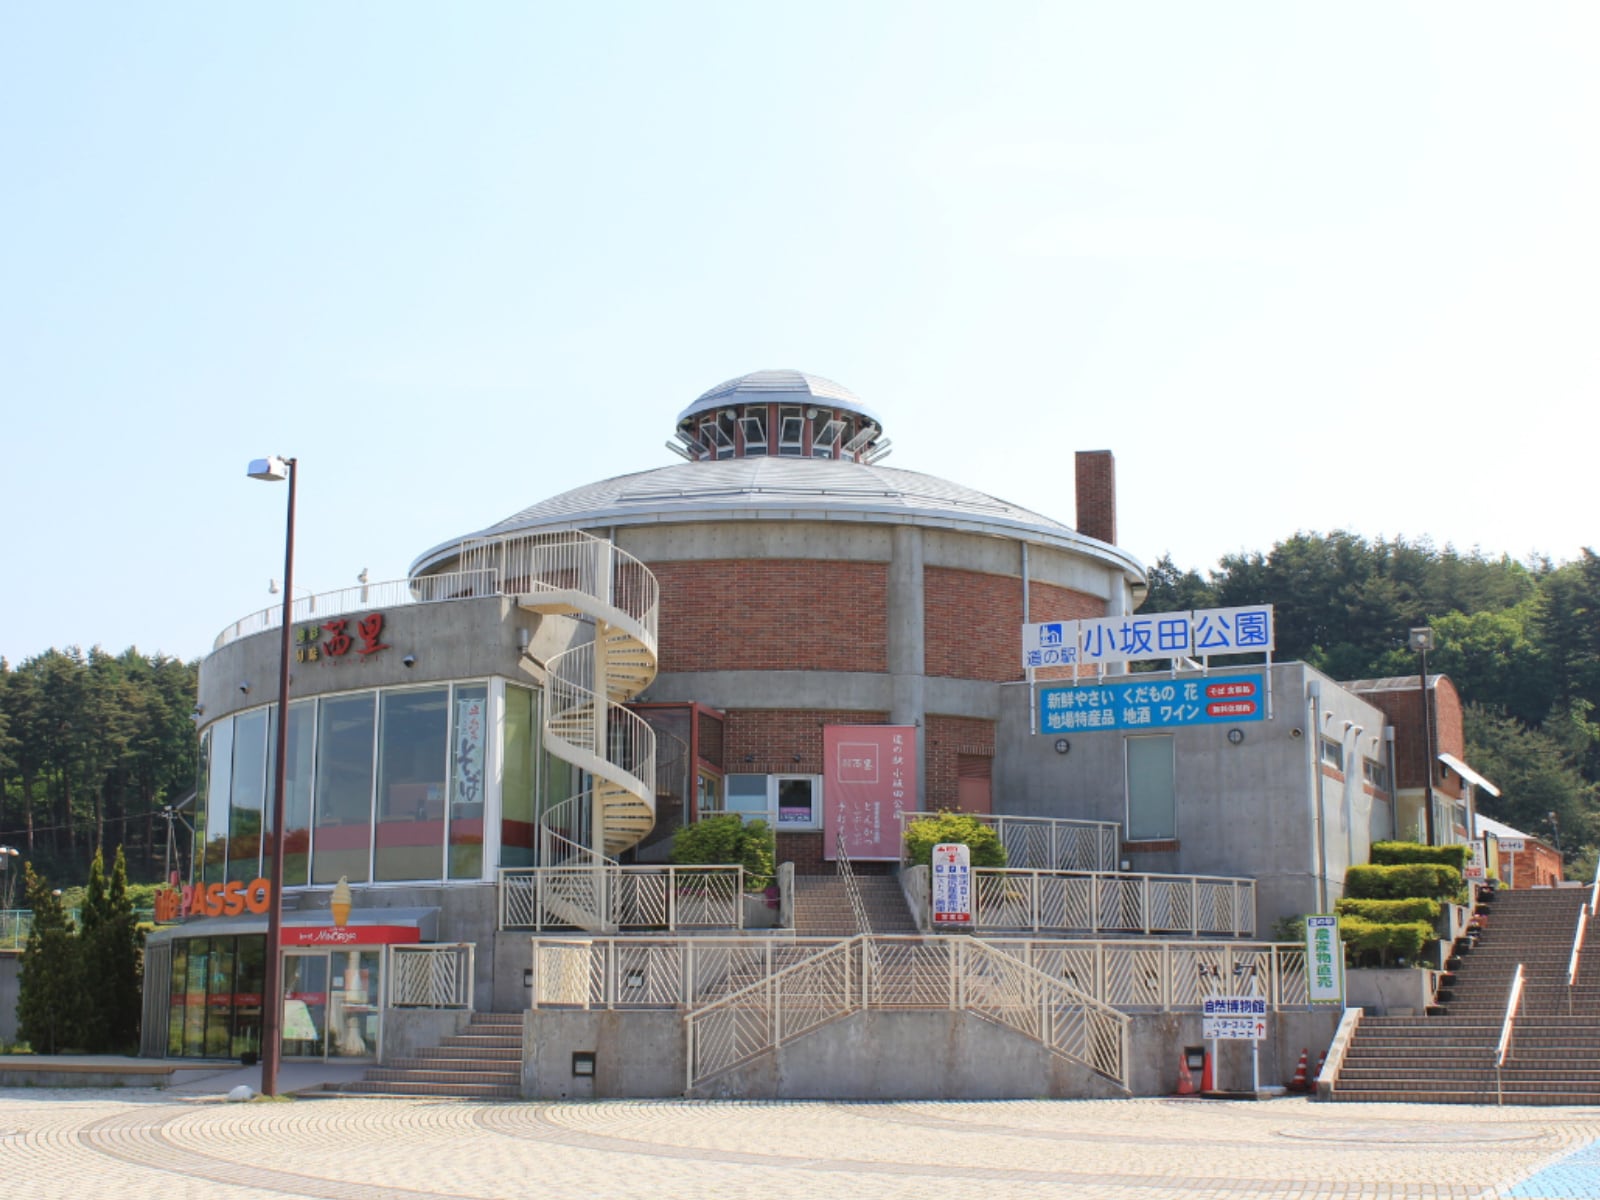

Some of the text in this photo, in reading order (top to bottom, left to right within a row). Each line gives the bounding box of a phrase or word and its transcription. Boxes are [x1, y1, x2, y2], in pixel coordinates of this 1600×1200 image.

[1084, 611, 1268, 657] 小坂田公園
[1027, 647, 1077, 666] 道の駅
[1048, 683, 1198, 709] 新鮮やさい くだもの 花
[1048, 704, 1199, 729] 地場特産品 地酒 ワイン
[458, 738, 481, 801] そば
[181, 878, 271, 918] PASSO
[1315, 928, 1333, 988] 農産物直売
[1205, 1000, 1265, 1014] 自然博物館
